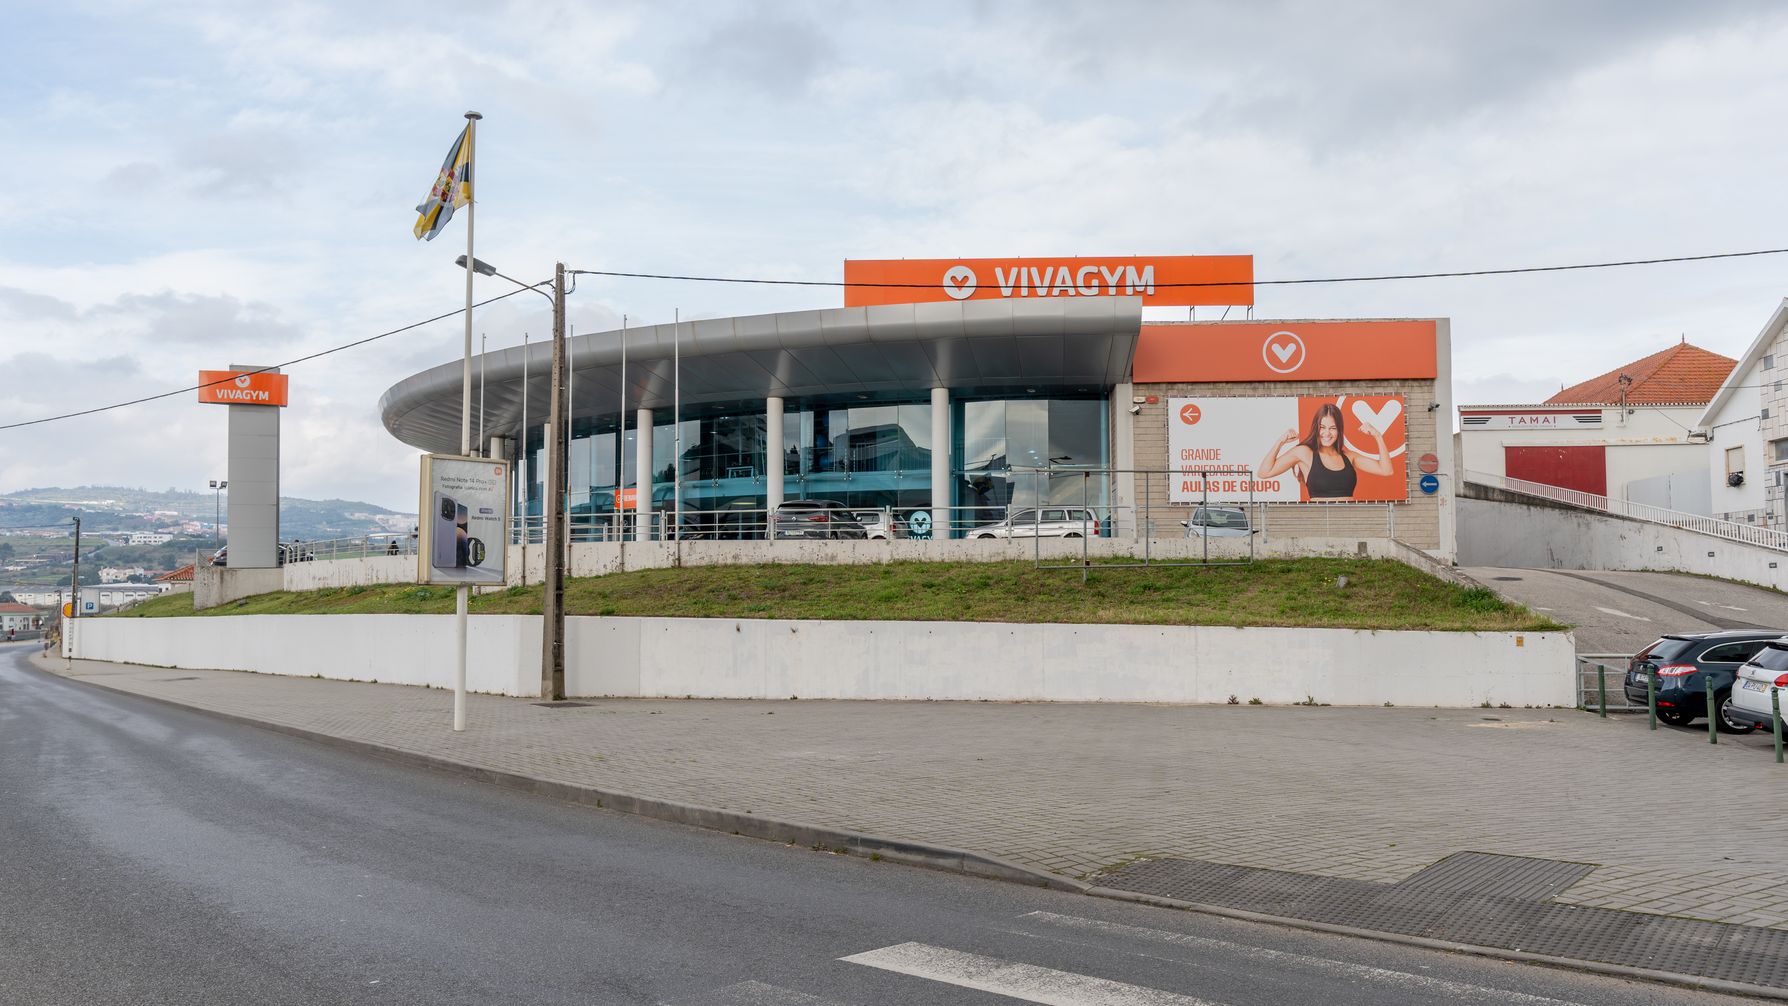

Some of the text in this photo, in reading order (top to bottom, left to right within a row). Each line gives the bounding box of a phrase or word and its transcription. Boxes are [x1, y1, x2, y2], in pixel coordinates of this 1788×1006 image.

[994, 265, 1156, 296] VIVAGYM
[216, 389, 269, 401] VIVAGYM
[1508, 416, 1556, 424] TAMAI
[1181, 448, 1221, 461] GRANDE
[1181, 464, 1250, 477] VARIEDADE DE
[1182, 480, 1281, 493] AULAS DE GRUPO
